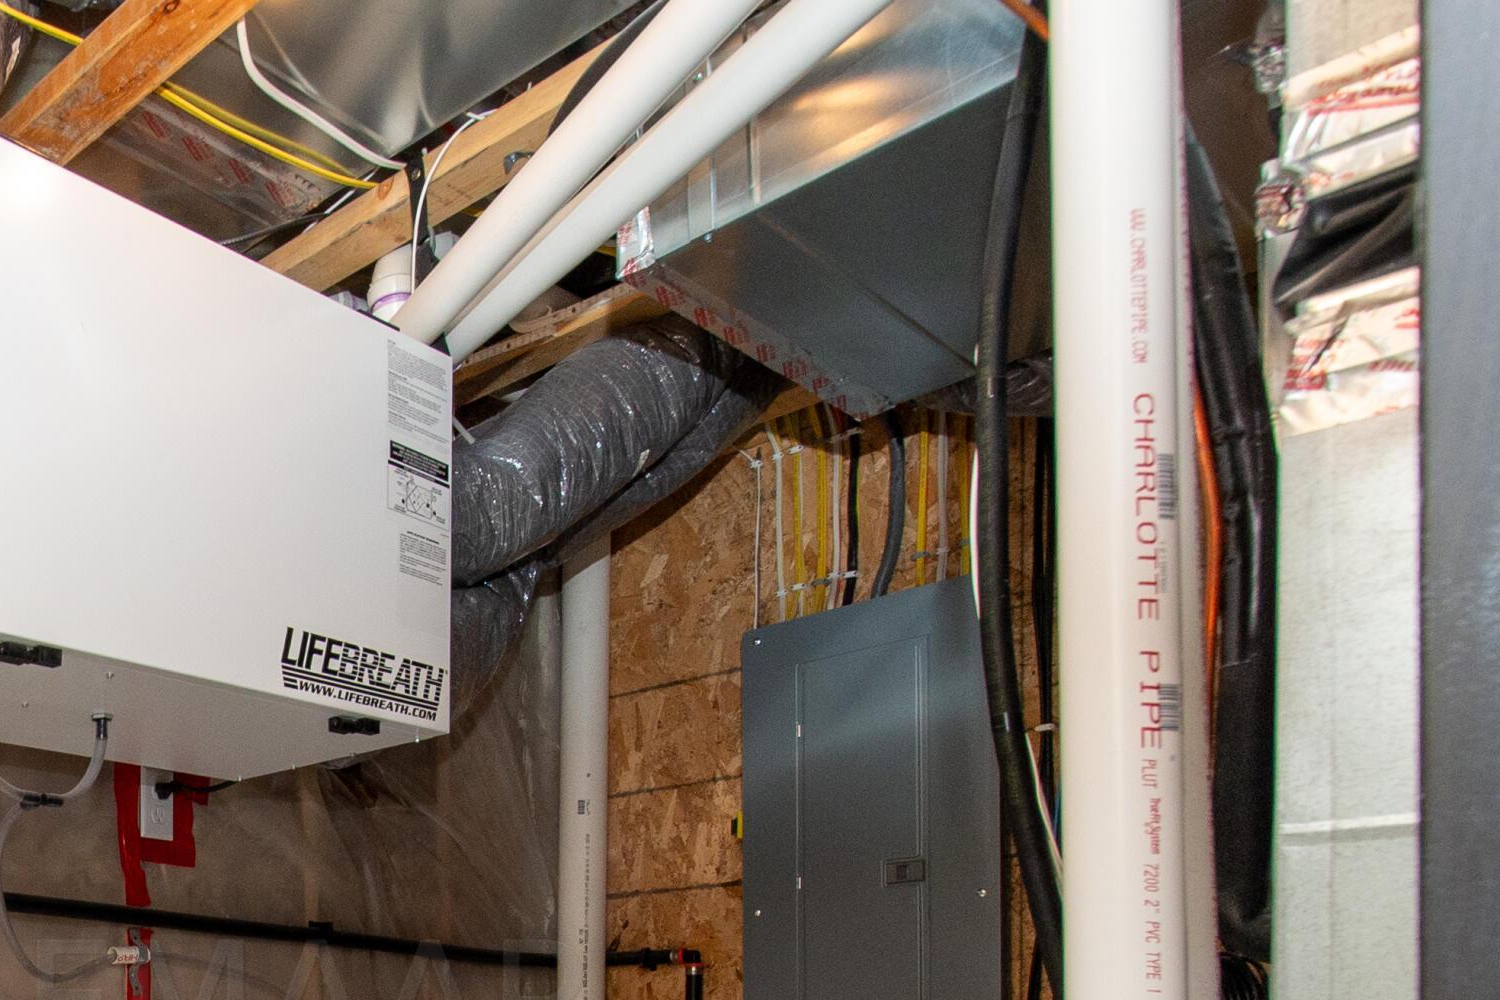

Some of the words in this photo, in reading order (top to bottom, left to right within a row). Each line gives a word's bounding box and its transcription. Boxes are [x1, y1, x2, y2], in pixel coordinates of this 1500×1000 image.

[1132, 393, 1160, 622] CHARLOTTE
[280, 626, 445, 702] LIFEBREATH
[298, 679, 438, 722] WWW.LIFEBREATH.COM
[1137, 650, 1163, 750] PIPE
[1143, 864, 1160, 892] 7200
[1145, 921, 1161, 944] PVC
[1145, 952, 1162, 981] TYPE
